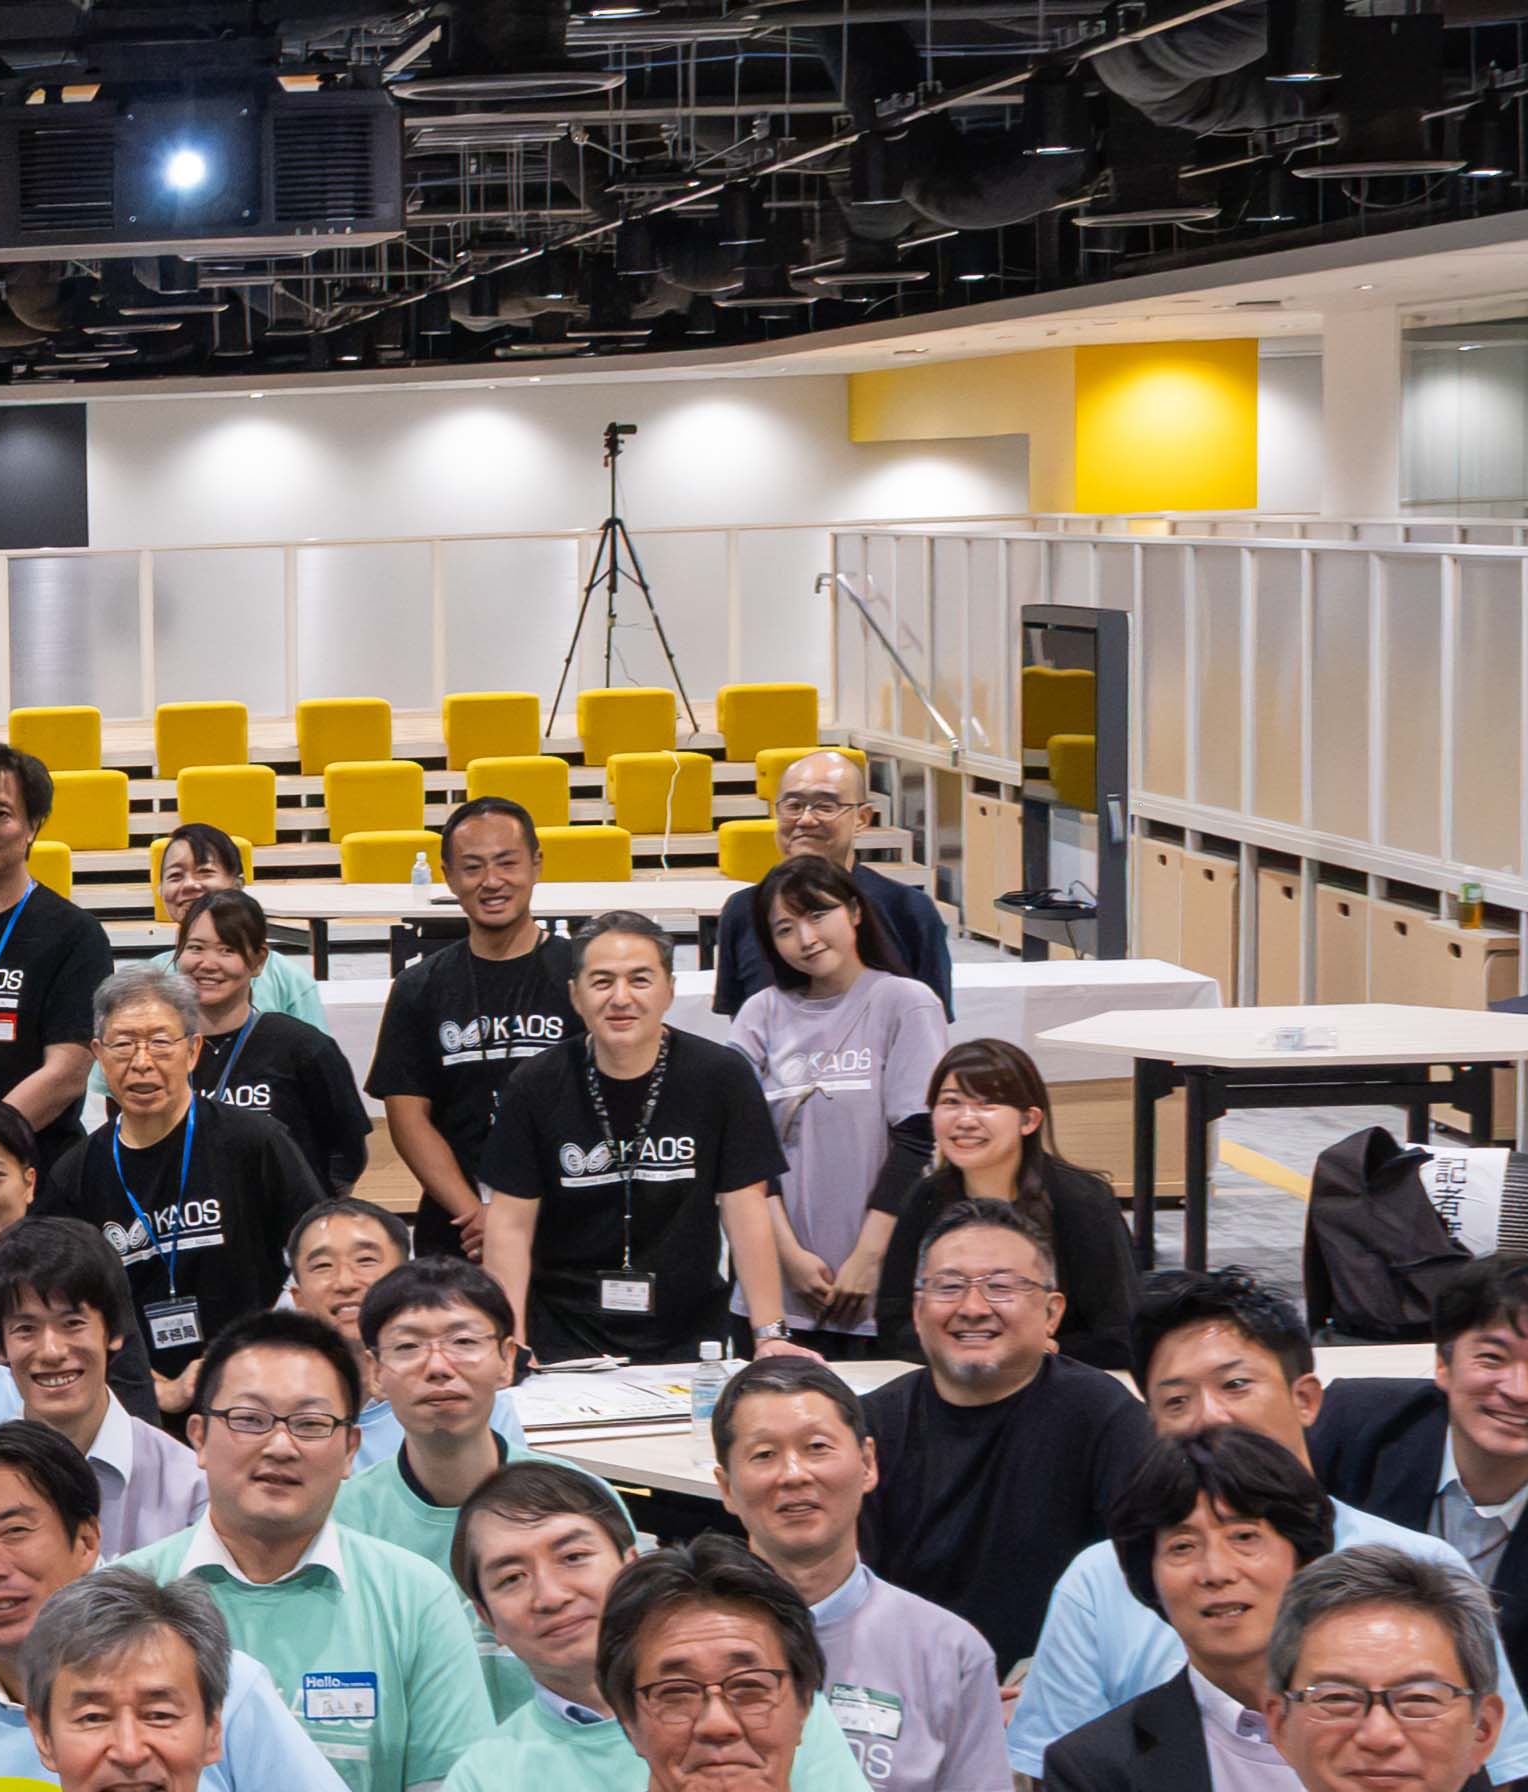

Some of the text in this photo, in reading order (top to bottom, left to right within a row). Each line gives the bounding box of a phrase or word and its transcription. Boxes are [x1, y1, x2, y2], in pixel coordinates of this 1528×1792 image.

[493, 1014, 563, 1040] KAOS
[810, 1048, 873, 1071] KAOS
[619, 1137, 696, 1161] KAOS
[154, 1199, 221, 1234] KAOS
[306, 1674, 341, 1689] Hello
